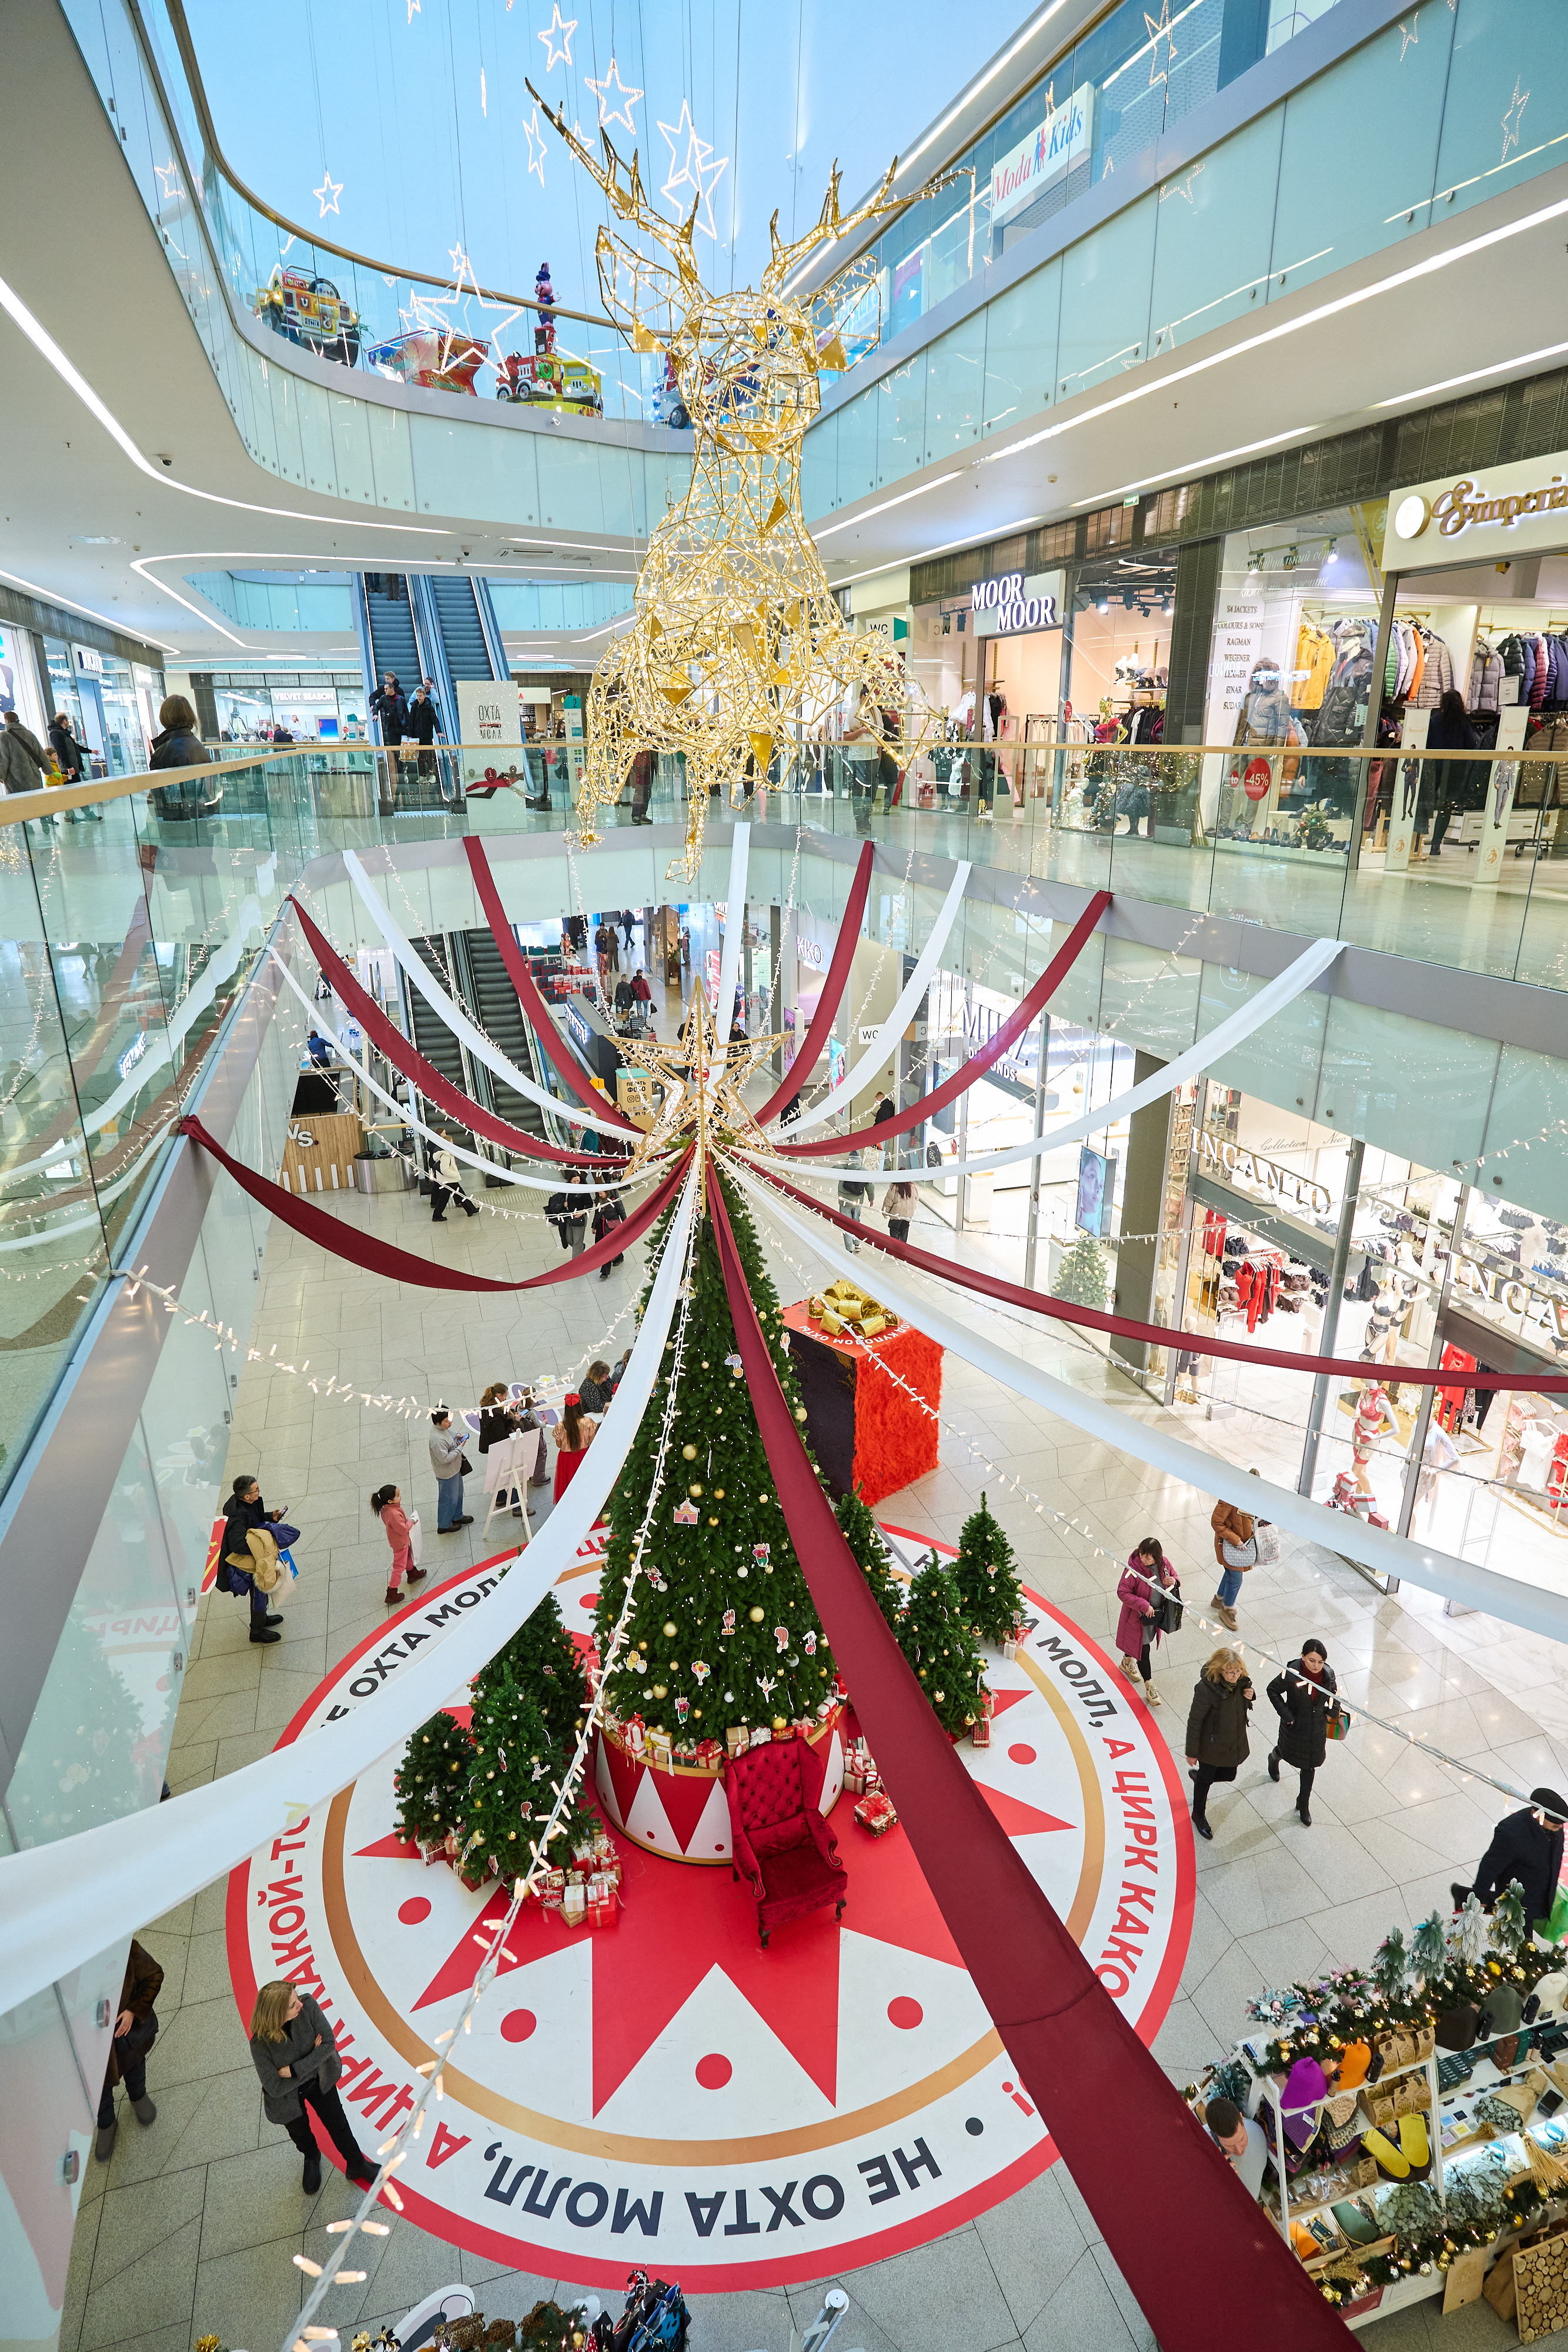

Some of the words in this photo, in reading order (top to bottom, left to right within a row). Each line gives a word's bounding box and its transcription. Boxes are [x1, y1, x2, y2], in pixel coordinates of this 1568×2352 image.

[992, 153, 1032, 207] Moda
[1047, 105, 1084, 161] Kids
[971, 573, 1027, 612] MOOR
[995, 596, 1057, 633] MOOR
[1233, 606, 1258, 614] JACKETS
[870, 624, 888, 634] WC
[1218, 622, 1243, 630] COLOURS
[1249, 622, 1264, 630] SONS
[1226, 638, 1251, 646] RAGMAN
[1224, 654, 1250, 662] WEGENER
[273, 692, 302, 701] VELVET
[303, 692, 335, 701] SEASON
[1226, 686, 1242, 694] SINAR
[573, 698, 577, 708] 2
[1223, 701, 1241, 710] SUDAR
[479, 706, 501, 721] ОХТА
[1231, 774, 1238, 784] to
[1245, 773, 1269, 786] -45%
[796, 935, 824, 964] KIKO
[862, 1030, 879, 1040] WC
[1259, 1138, 1308, 1151] Collection
[1191, 1125, 1331, 1215] INCANTO
[1438, 1248, 1568, 1340] INCA
[798, 1325, 829, 1341] ОХТЫ
[349, 1632, 432, 1697] ОХТА
[424, 1577, 499, 1628] МОЛ
[1035, 1636, 1118, 1728] МОЛЛ,
[1102, 1737, 1136, 1760] А
[1112, 1770, 1159, 1875] ЦИРК
[1094, 1880, 1156, 1999] КАКО
[425, 2121, 473, 2170] А
[857, 2136, 942, 2206] НЕ
[483, 2141, 664, 2237] МОЛЛ,
[684, 2173, 845, 2237] ОХТА
